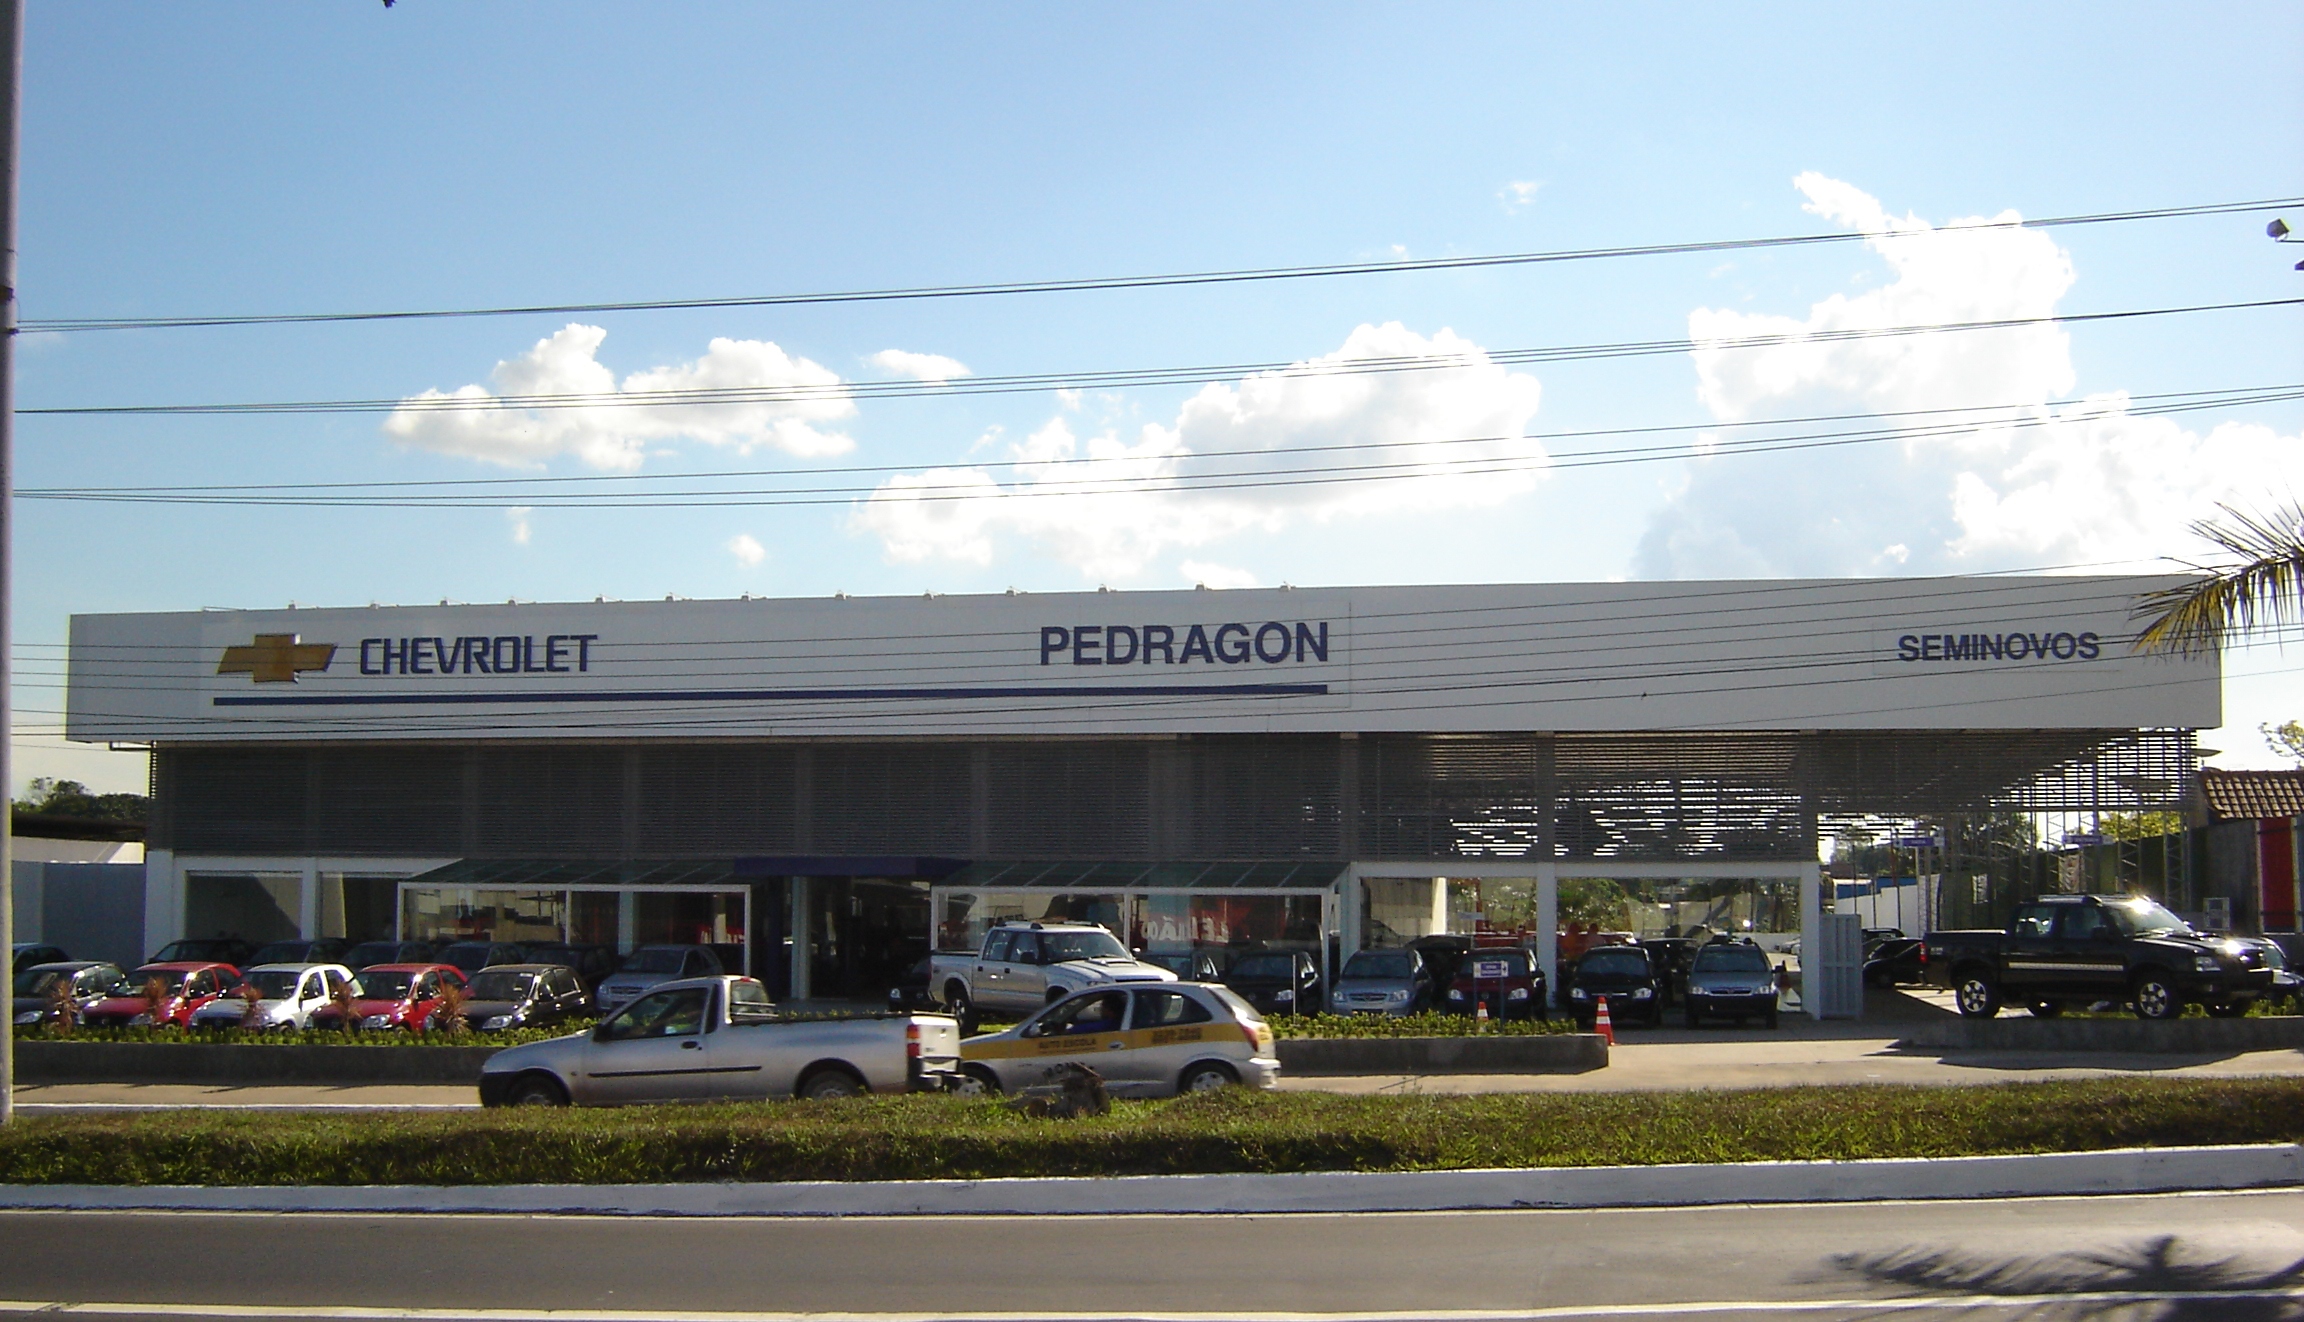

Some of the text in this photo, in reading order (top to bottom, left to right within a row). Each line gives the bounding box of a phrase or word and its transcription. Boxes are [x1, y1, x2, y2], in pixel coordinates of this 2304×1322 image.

[360, 634, 598, 675] CHEVROLET
[1040, 621, 1328, 666] PEDRAGON
[1898, 633, 2100, 662] SEMINOVOS
